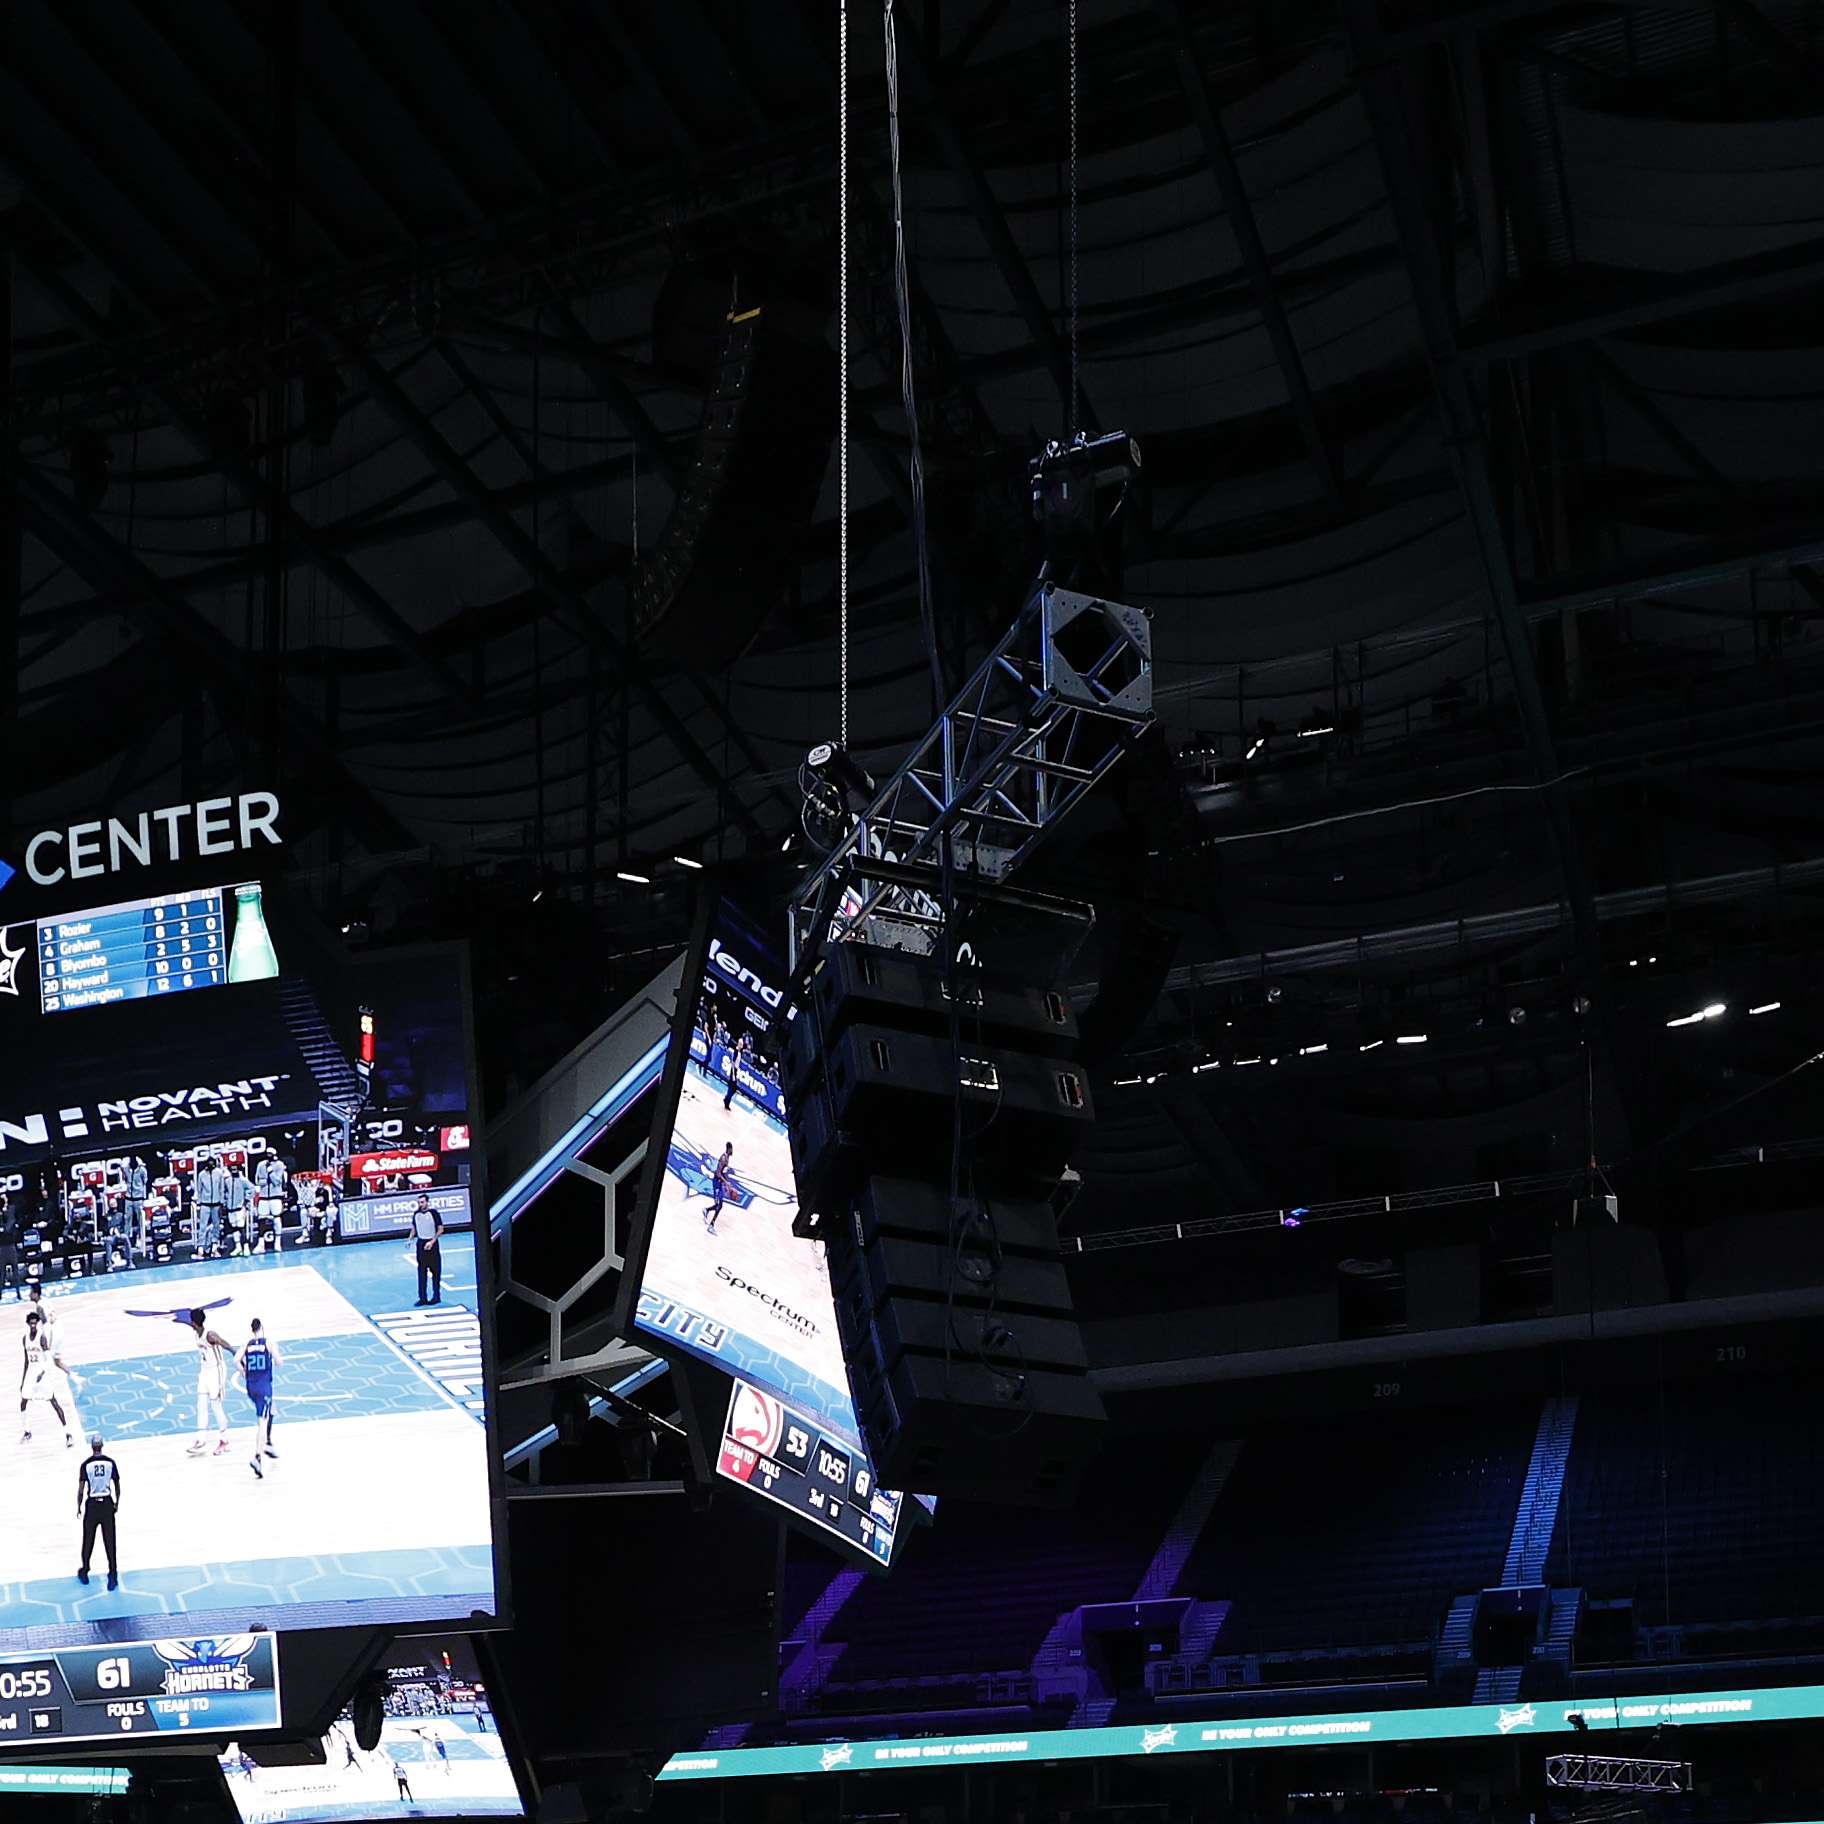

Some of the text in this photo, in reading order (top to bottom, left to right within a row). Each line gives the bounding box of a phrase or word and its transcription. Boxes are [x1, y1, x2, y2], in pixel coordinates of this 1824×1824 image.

[26, 792, 282, 885] CENTER
[98, 1076, 278, 1117] NOVANT
[103, 1092, 271, 1132] HEALTH
[716, 1266, 816, 1333] Spectrum
[786, 1426, 870, 1497] 53 10:55 61
[98, 1657, 129, 1689] 61
[166, 1673, 246, 1695] HORNETS
[107, 1701, 144, 1717] FOULS
[156, 1697, 208, 1713] TEAM TO
